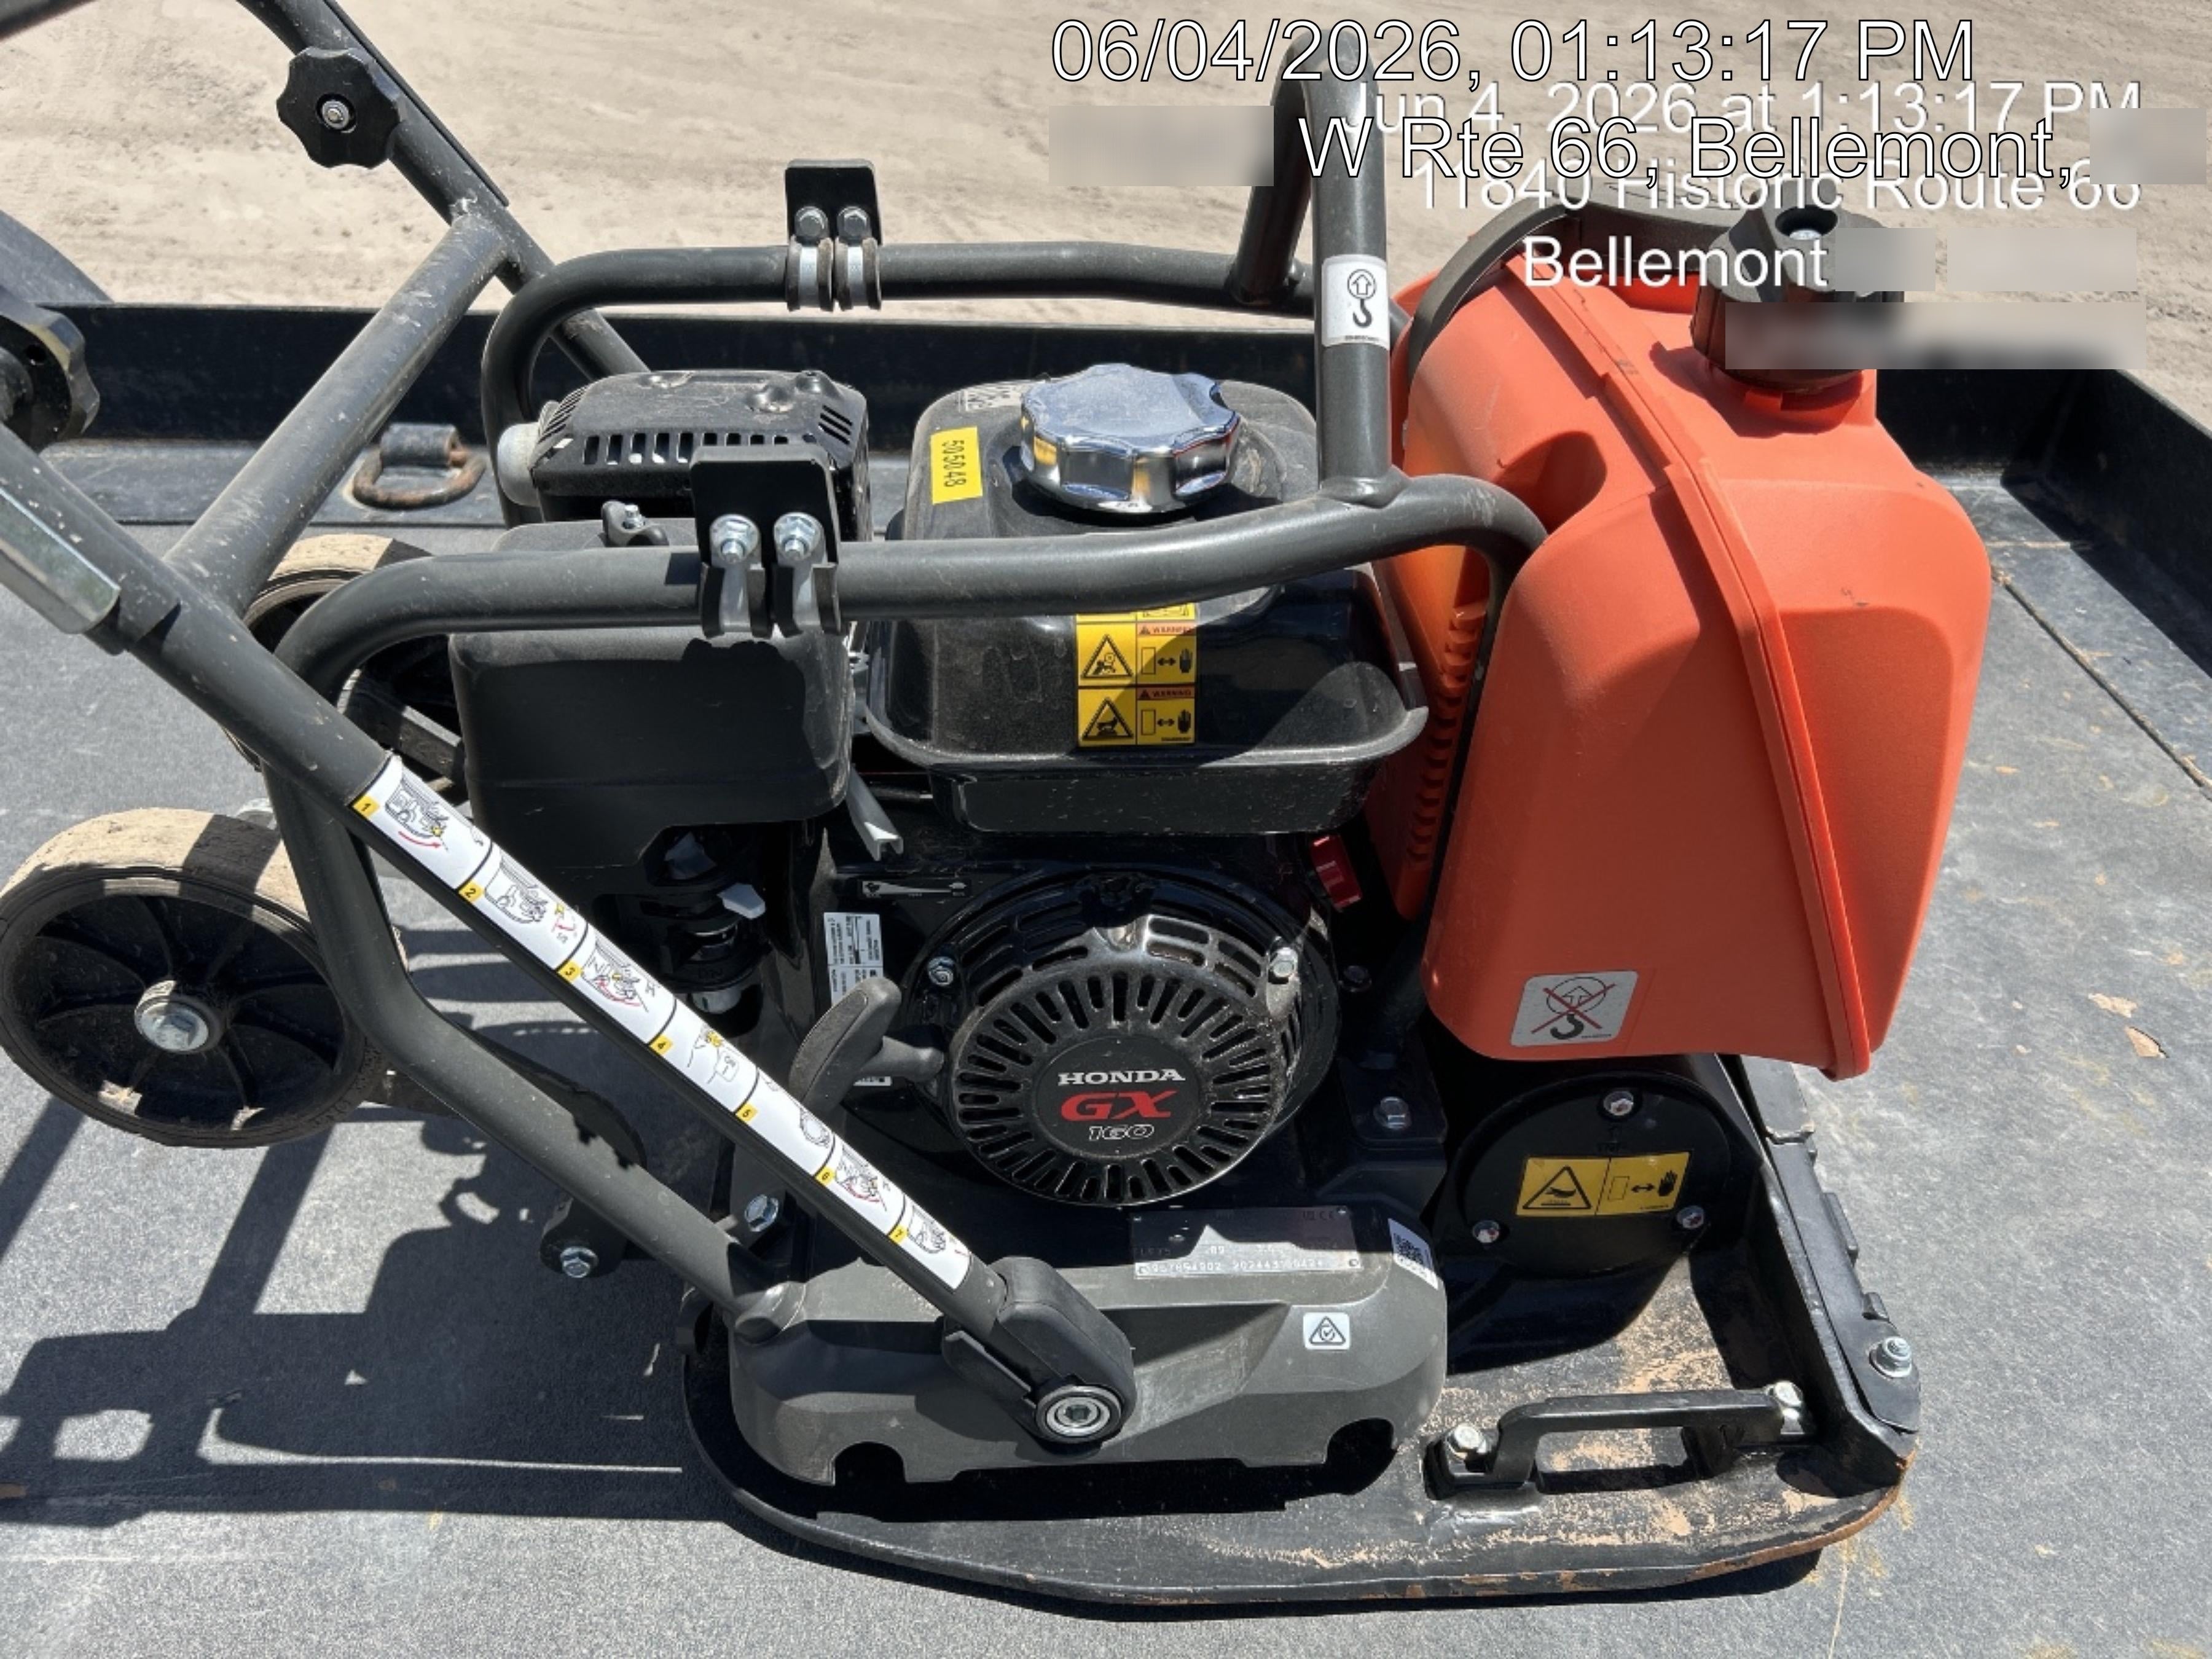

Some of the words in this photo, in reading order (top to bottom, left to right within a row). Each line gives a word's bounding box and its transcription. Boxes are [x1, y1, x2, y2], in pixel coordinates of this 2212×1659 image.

[941, 439, 967, 487] 505048
[465, 888, 476, 898] 2
[565, 967, 576, 976] 3
[1057, 1069, 1186, 1086] HONDA
[1061, 1090, 1178, 1121] GX
[1089, 1124, 1155, 1140] 160
